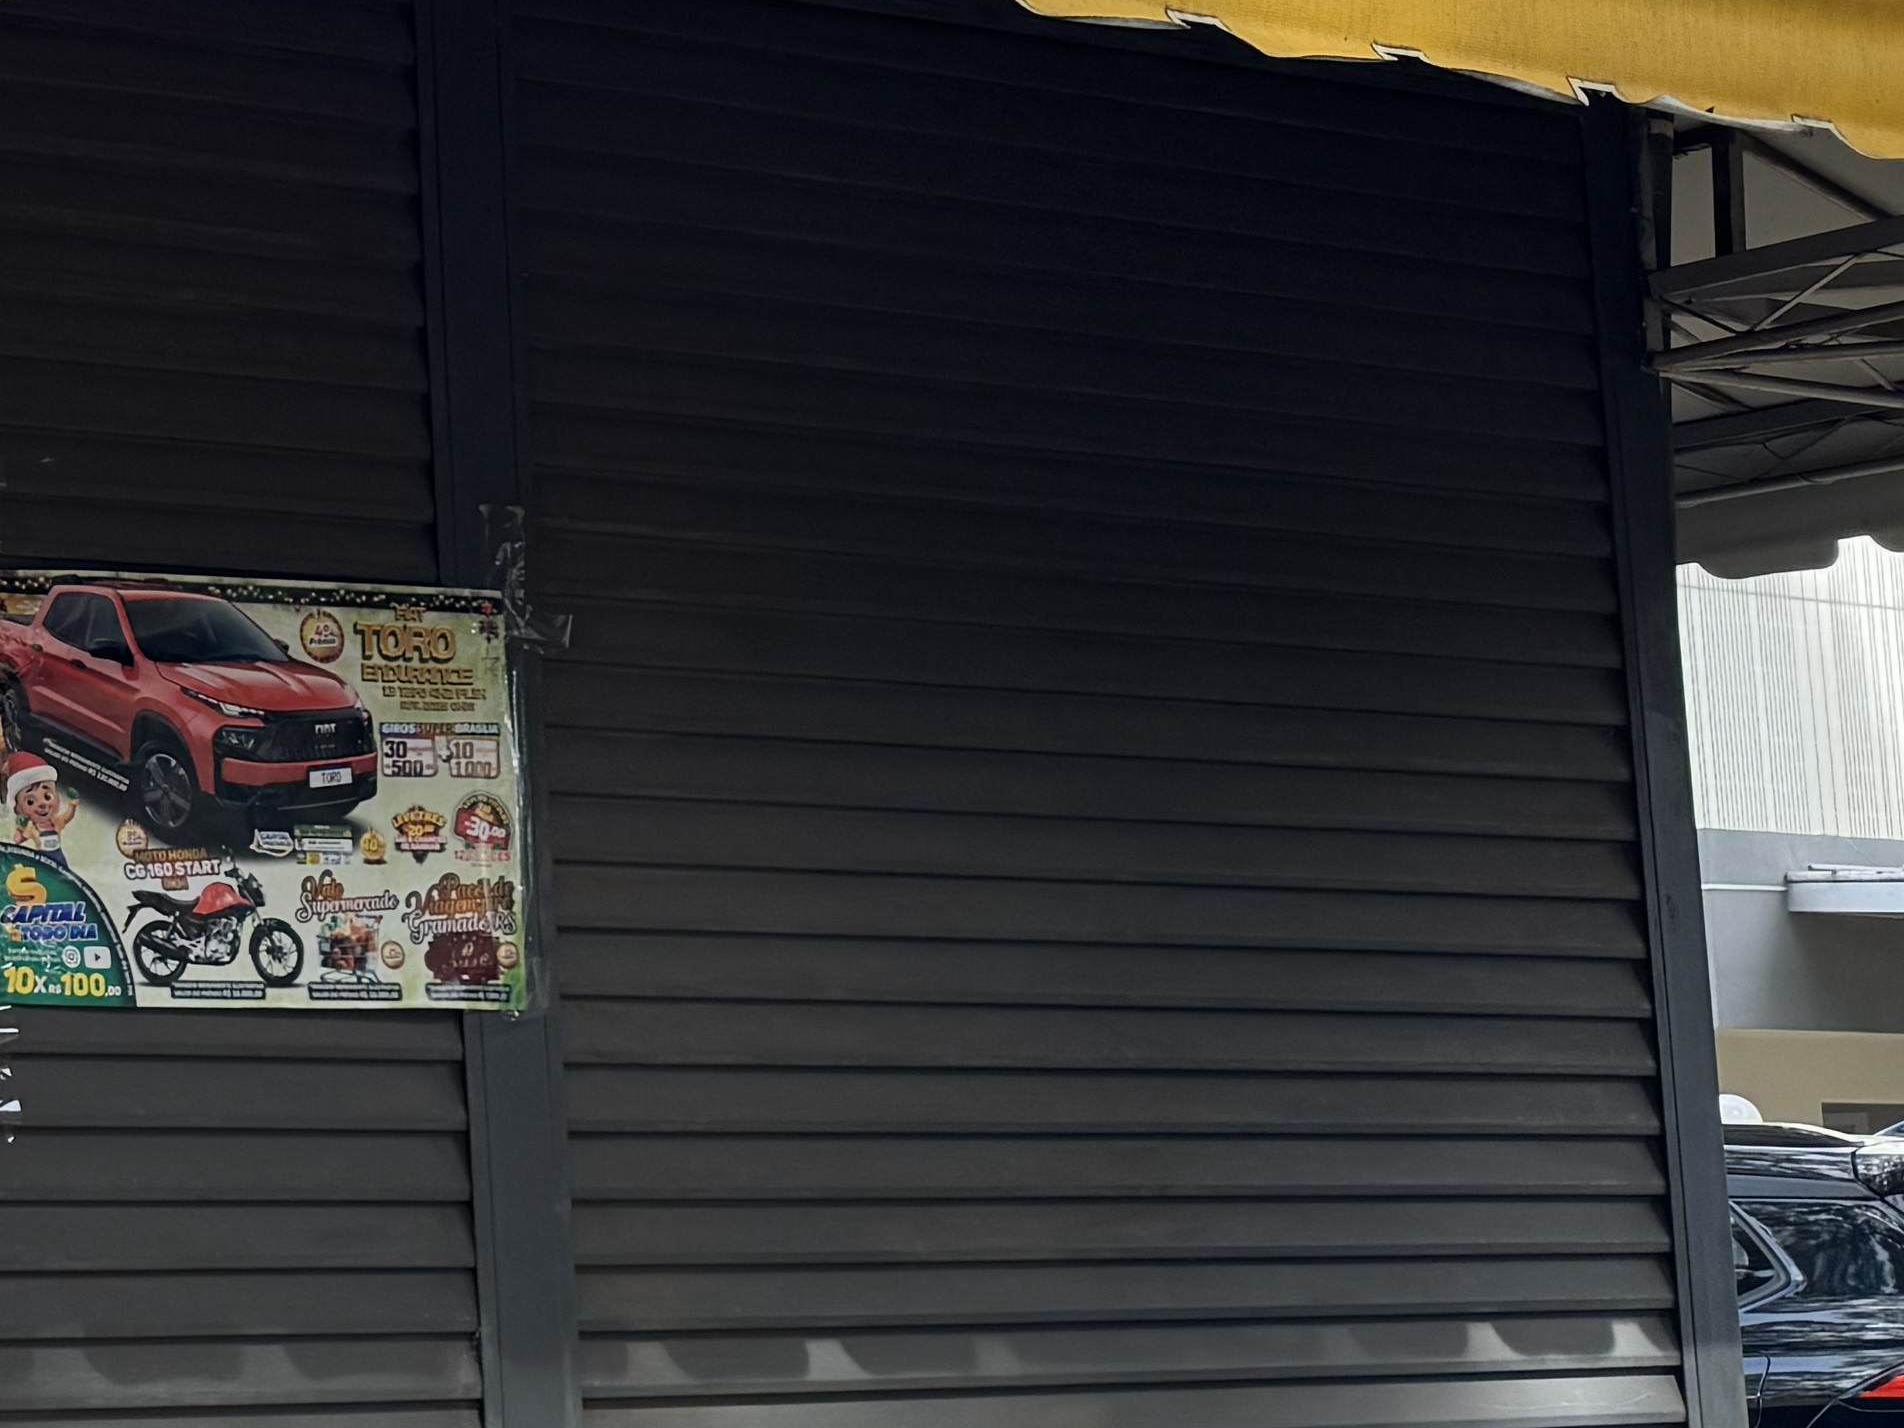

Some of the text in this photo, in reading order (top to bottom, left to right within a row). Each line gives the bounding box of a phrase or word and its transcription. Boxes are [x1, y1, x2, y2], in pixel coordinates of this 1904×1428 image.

[353, 621, 457, 664] TORO
[360, 662, 474, 685] ENDURANCE
[384, 740, 407, 759] 30
[453, 741, 474, 759] 10
[168, 848, 209, 861] HONDA
[125, 860, 221, 879] CG 160 START
[0, 901, 86, 925] CAPITAL
[295, 889, 399, 923] Supermercado
[21, 924, 68, 942] TODO
